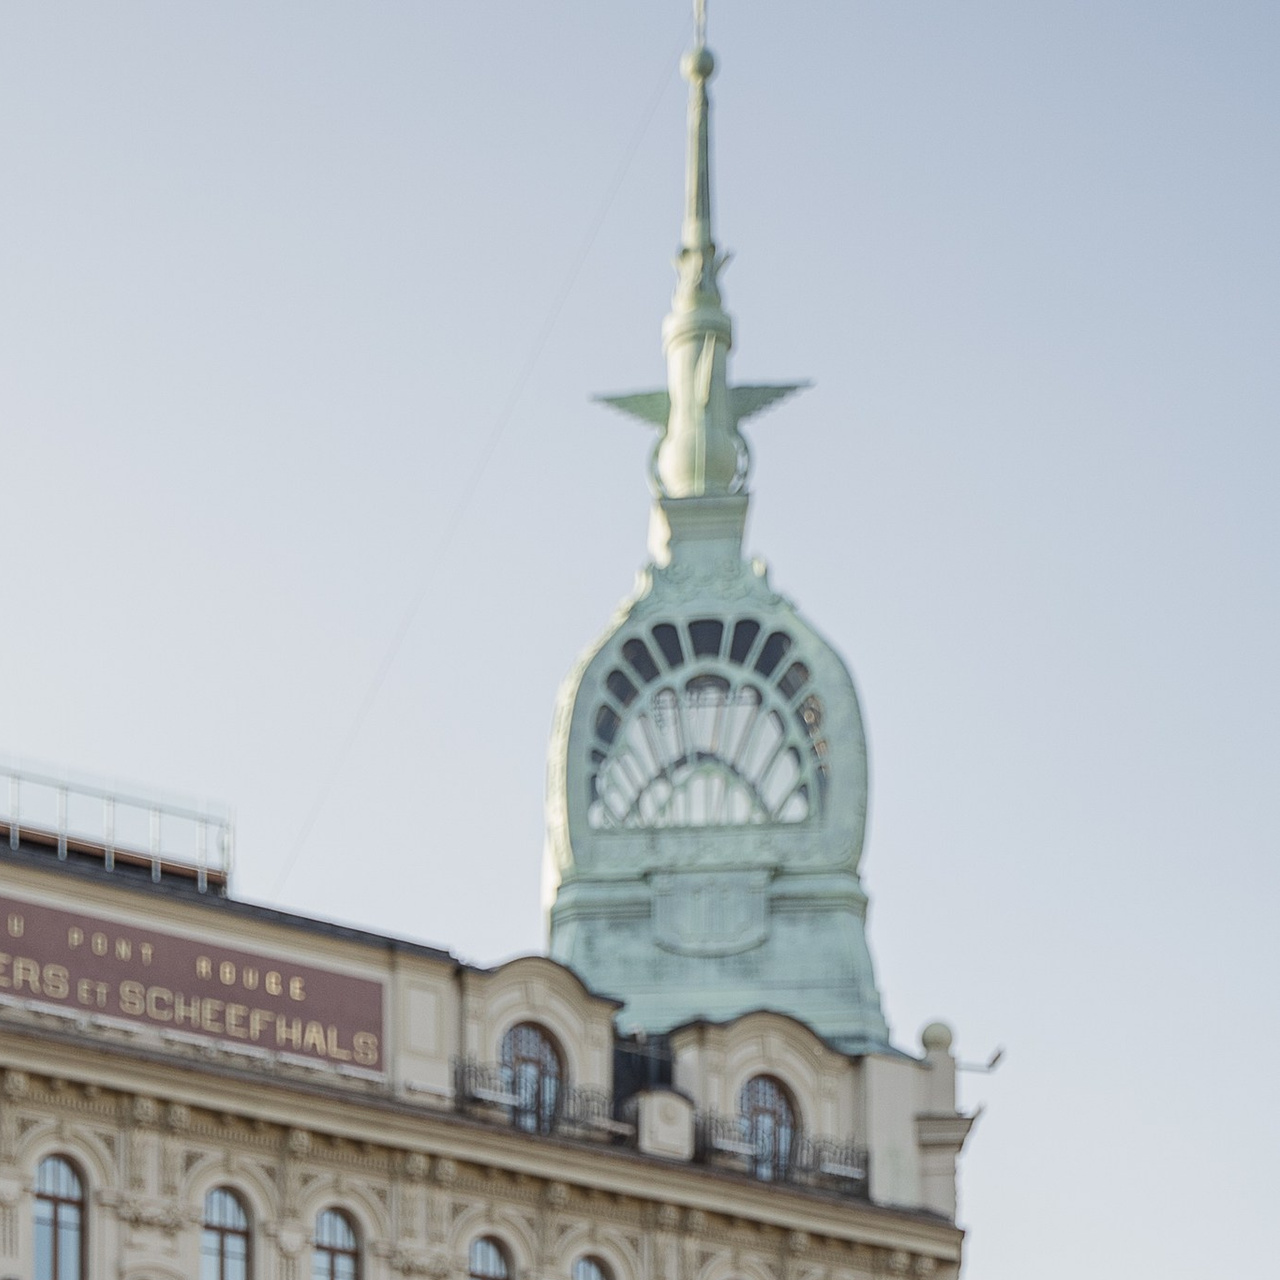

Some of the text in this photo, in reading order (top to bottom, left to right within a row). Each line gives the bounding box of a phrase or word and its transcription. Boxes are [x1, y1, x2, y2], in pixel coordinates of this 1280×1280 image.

[68, 926, 153, 966] PONT
[196, 956, 306, 1001] ROUGE
[77, 978, 109, 1008] ET
[120, 980, 379, 1066] SCHEEFHALS
